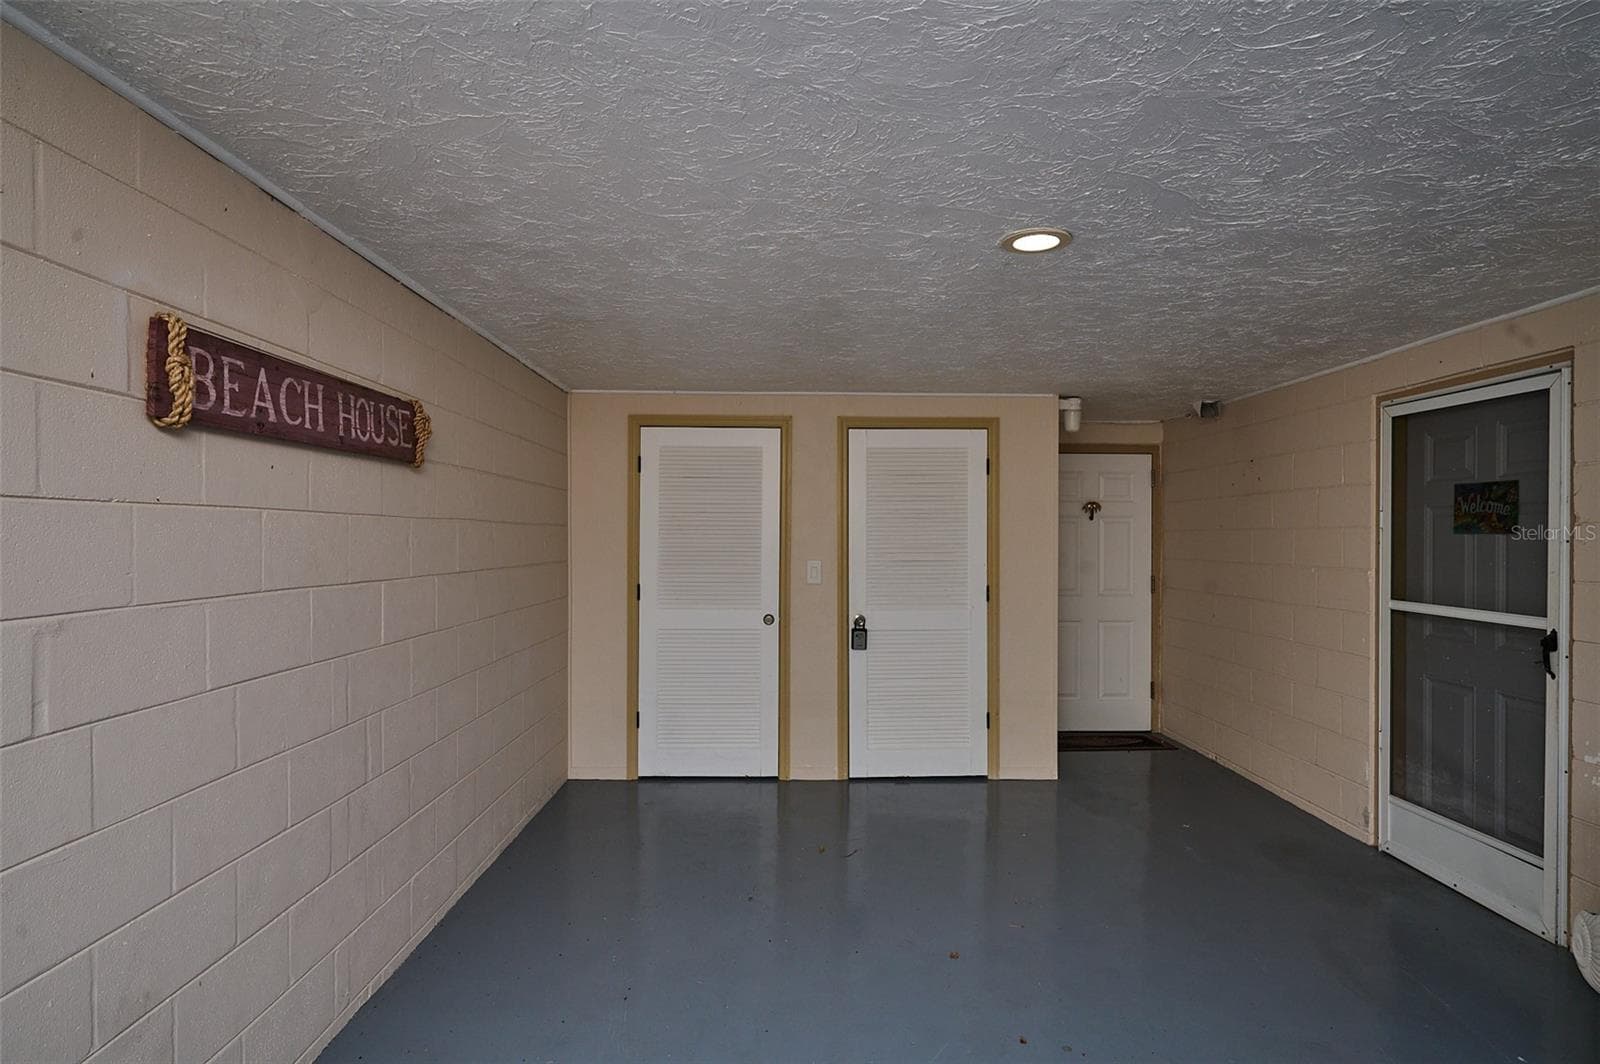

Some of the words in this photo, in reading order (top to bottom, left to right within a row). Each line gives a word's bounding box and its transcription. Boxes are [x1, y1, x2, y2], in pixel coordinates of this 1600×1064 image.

[189, 346, 325, 432] BEACH
[338, 392, 412, 448] HOUSE
[1459, 494, 1511, 515] Welcome
